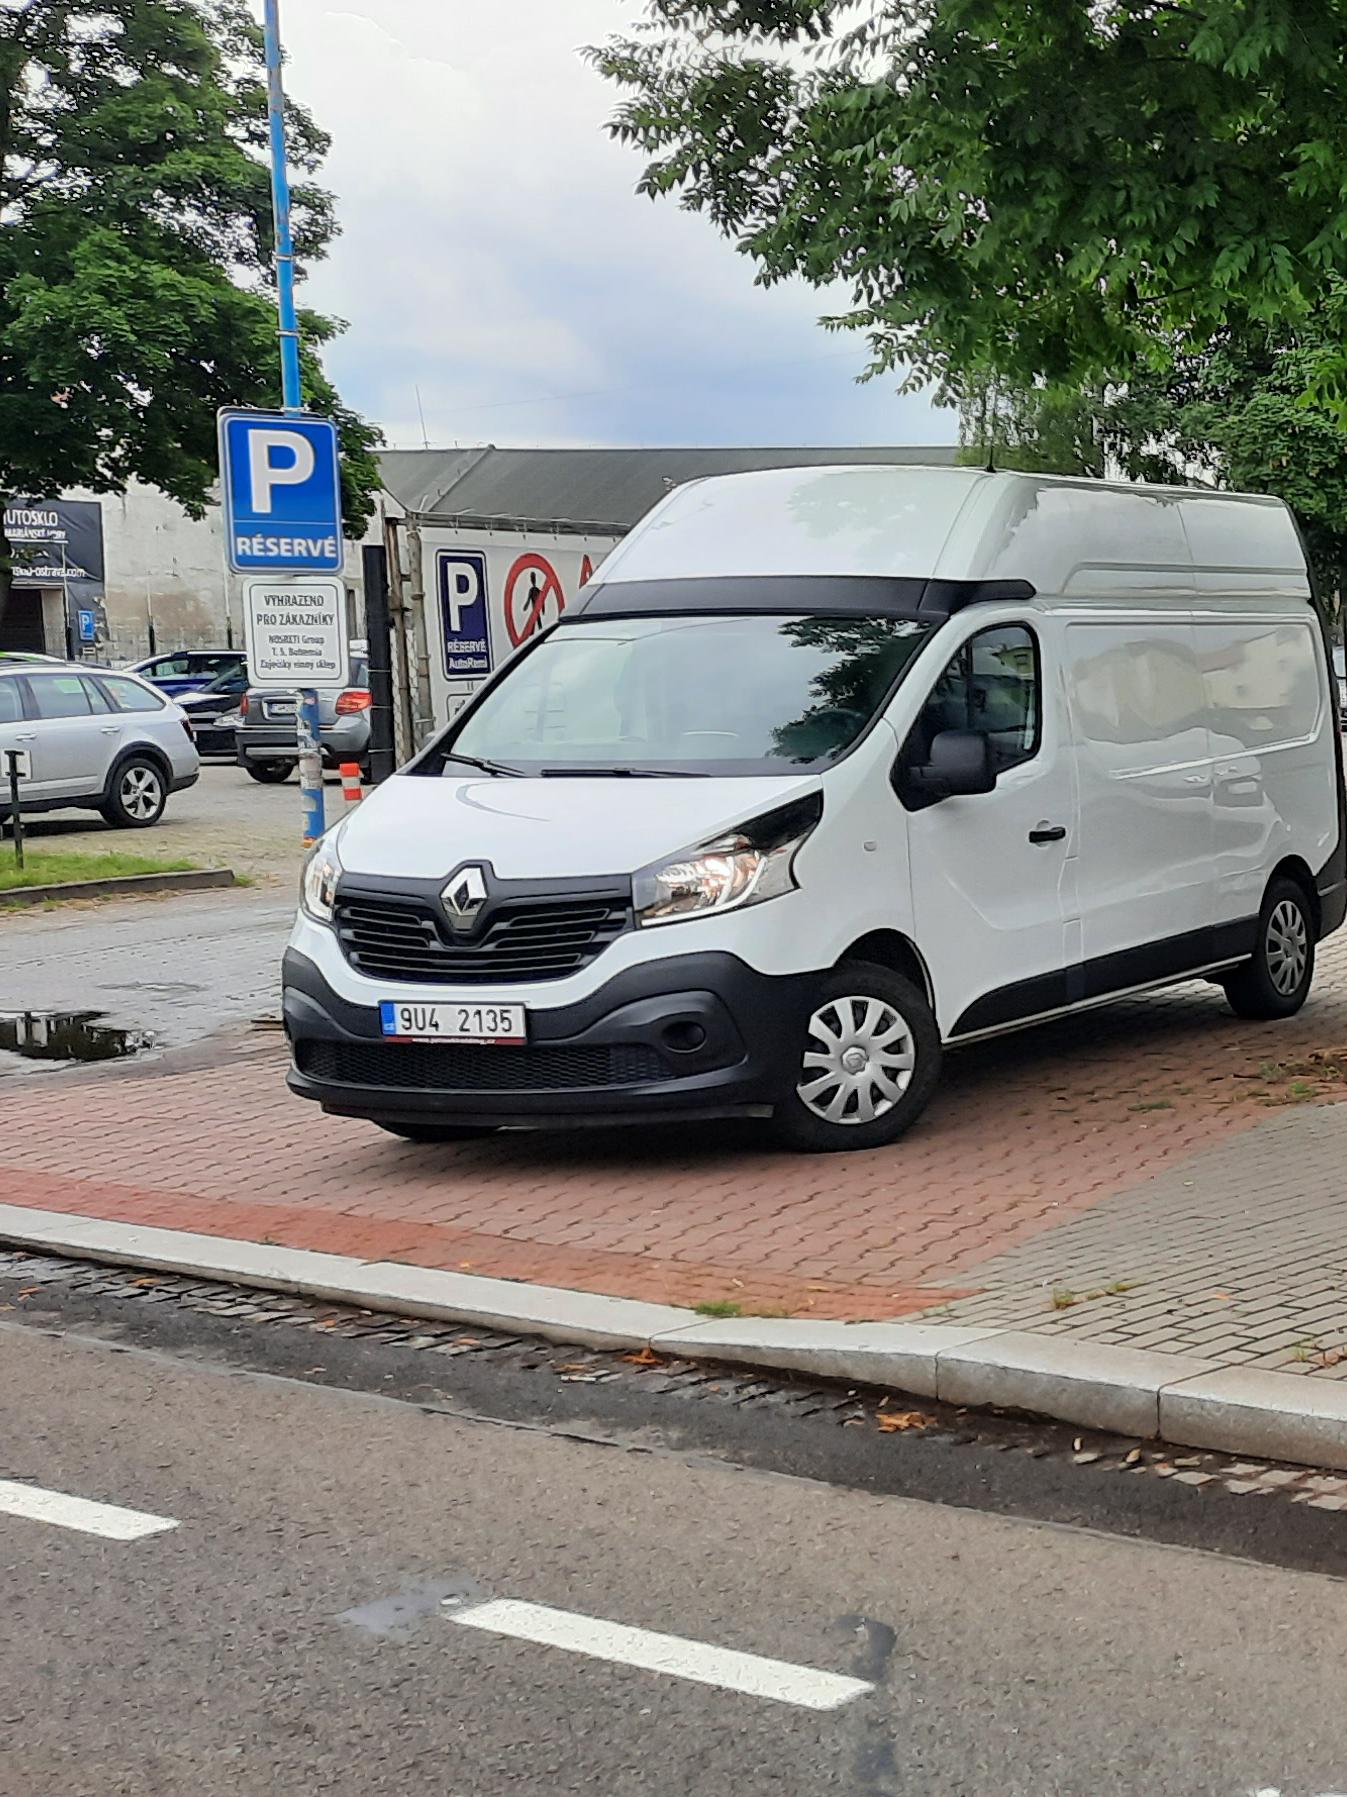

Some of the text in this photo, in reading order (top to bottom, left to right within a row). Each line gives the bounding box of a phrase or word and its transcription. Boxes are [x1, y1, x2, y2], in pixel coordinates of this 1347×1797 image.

[248, 429, 315, 513] P
[236, 534, 337, 558] RÉSERVÉ
[264, 595, 324, 606] VYHRAZENO
[446, 562, 478, 632] P
[82, 614, 90, 631] P
[256, 611, 335, 625] PRO ZÁKAZNÍKY
[400, 1007, 512, 1033] 9U4 2135
